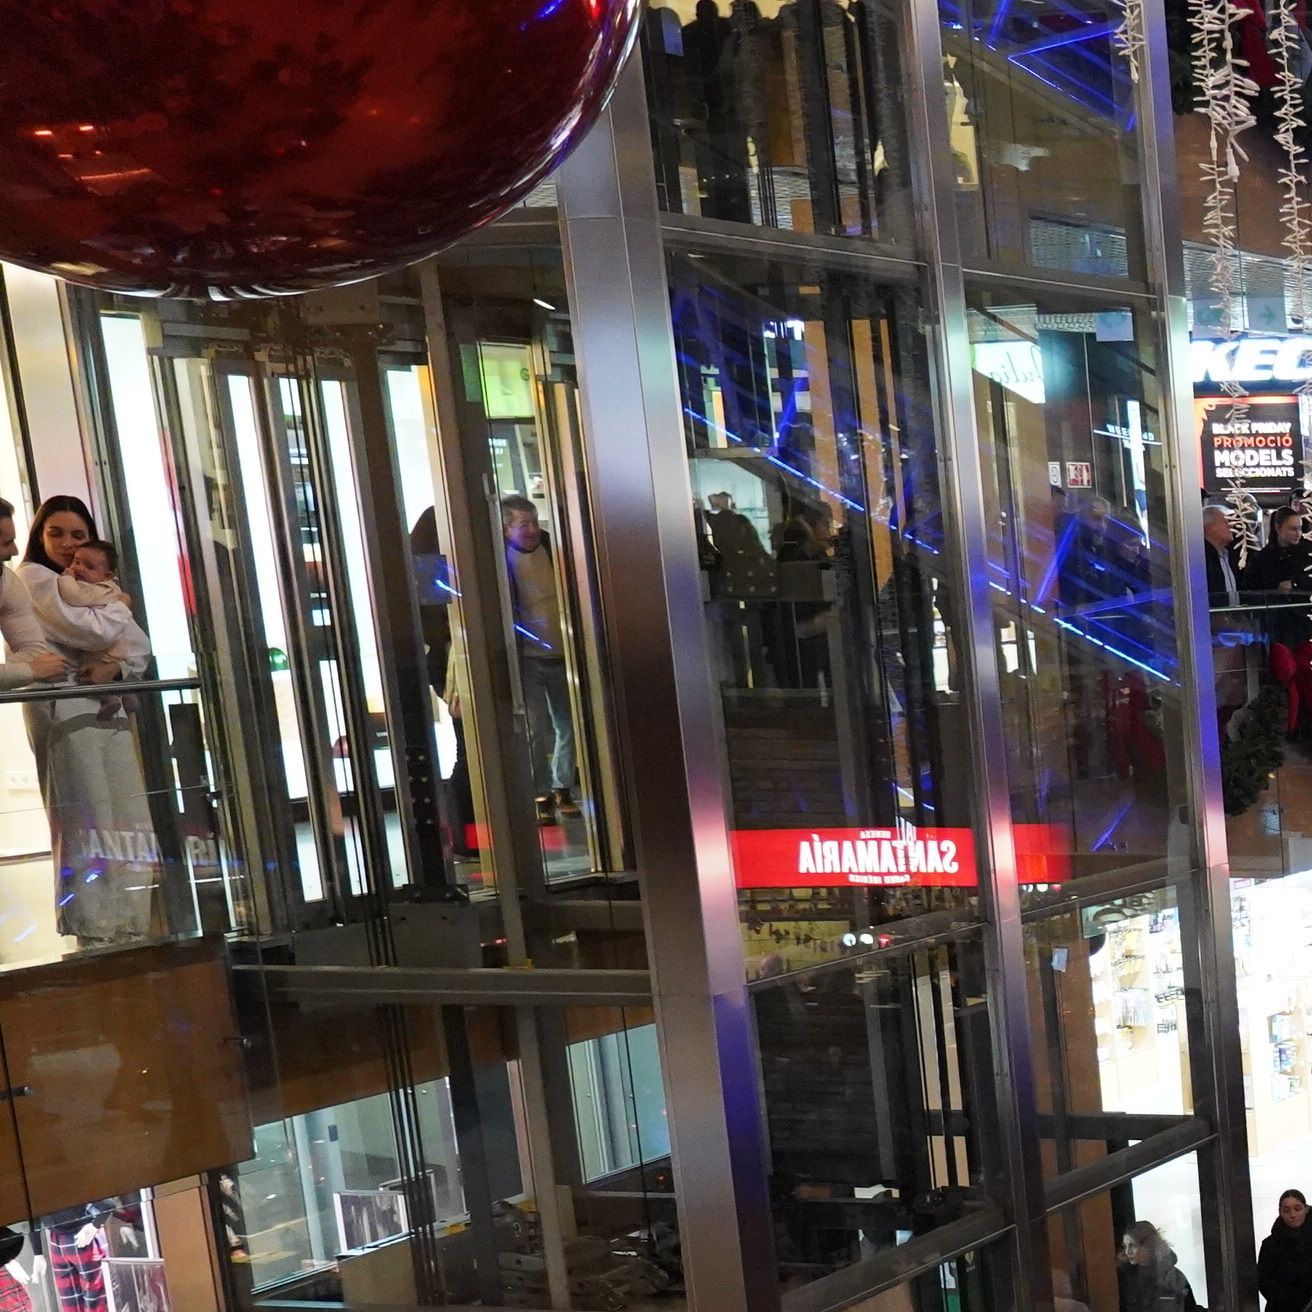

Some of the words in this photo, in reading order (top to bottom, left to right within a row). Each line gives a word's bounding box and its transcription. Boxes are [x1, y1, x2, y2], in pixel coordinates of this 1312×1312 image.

[1251, 422, 1292, 434] FRIDAY
[1213, 433, 1293, 448] PROMOCIÓ
[1215, 450, 1294, 467] MODELS
[1216, 467, 1294, 478] SELECCIONATS
